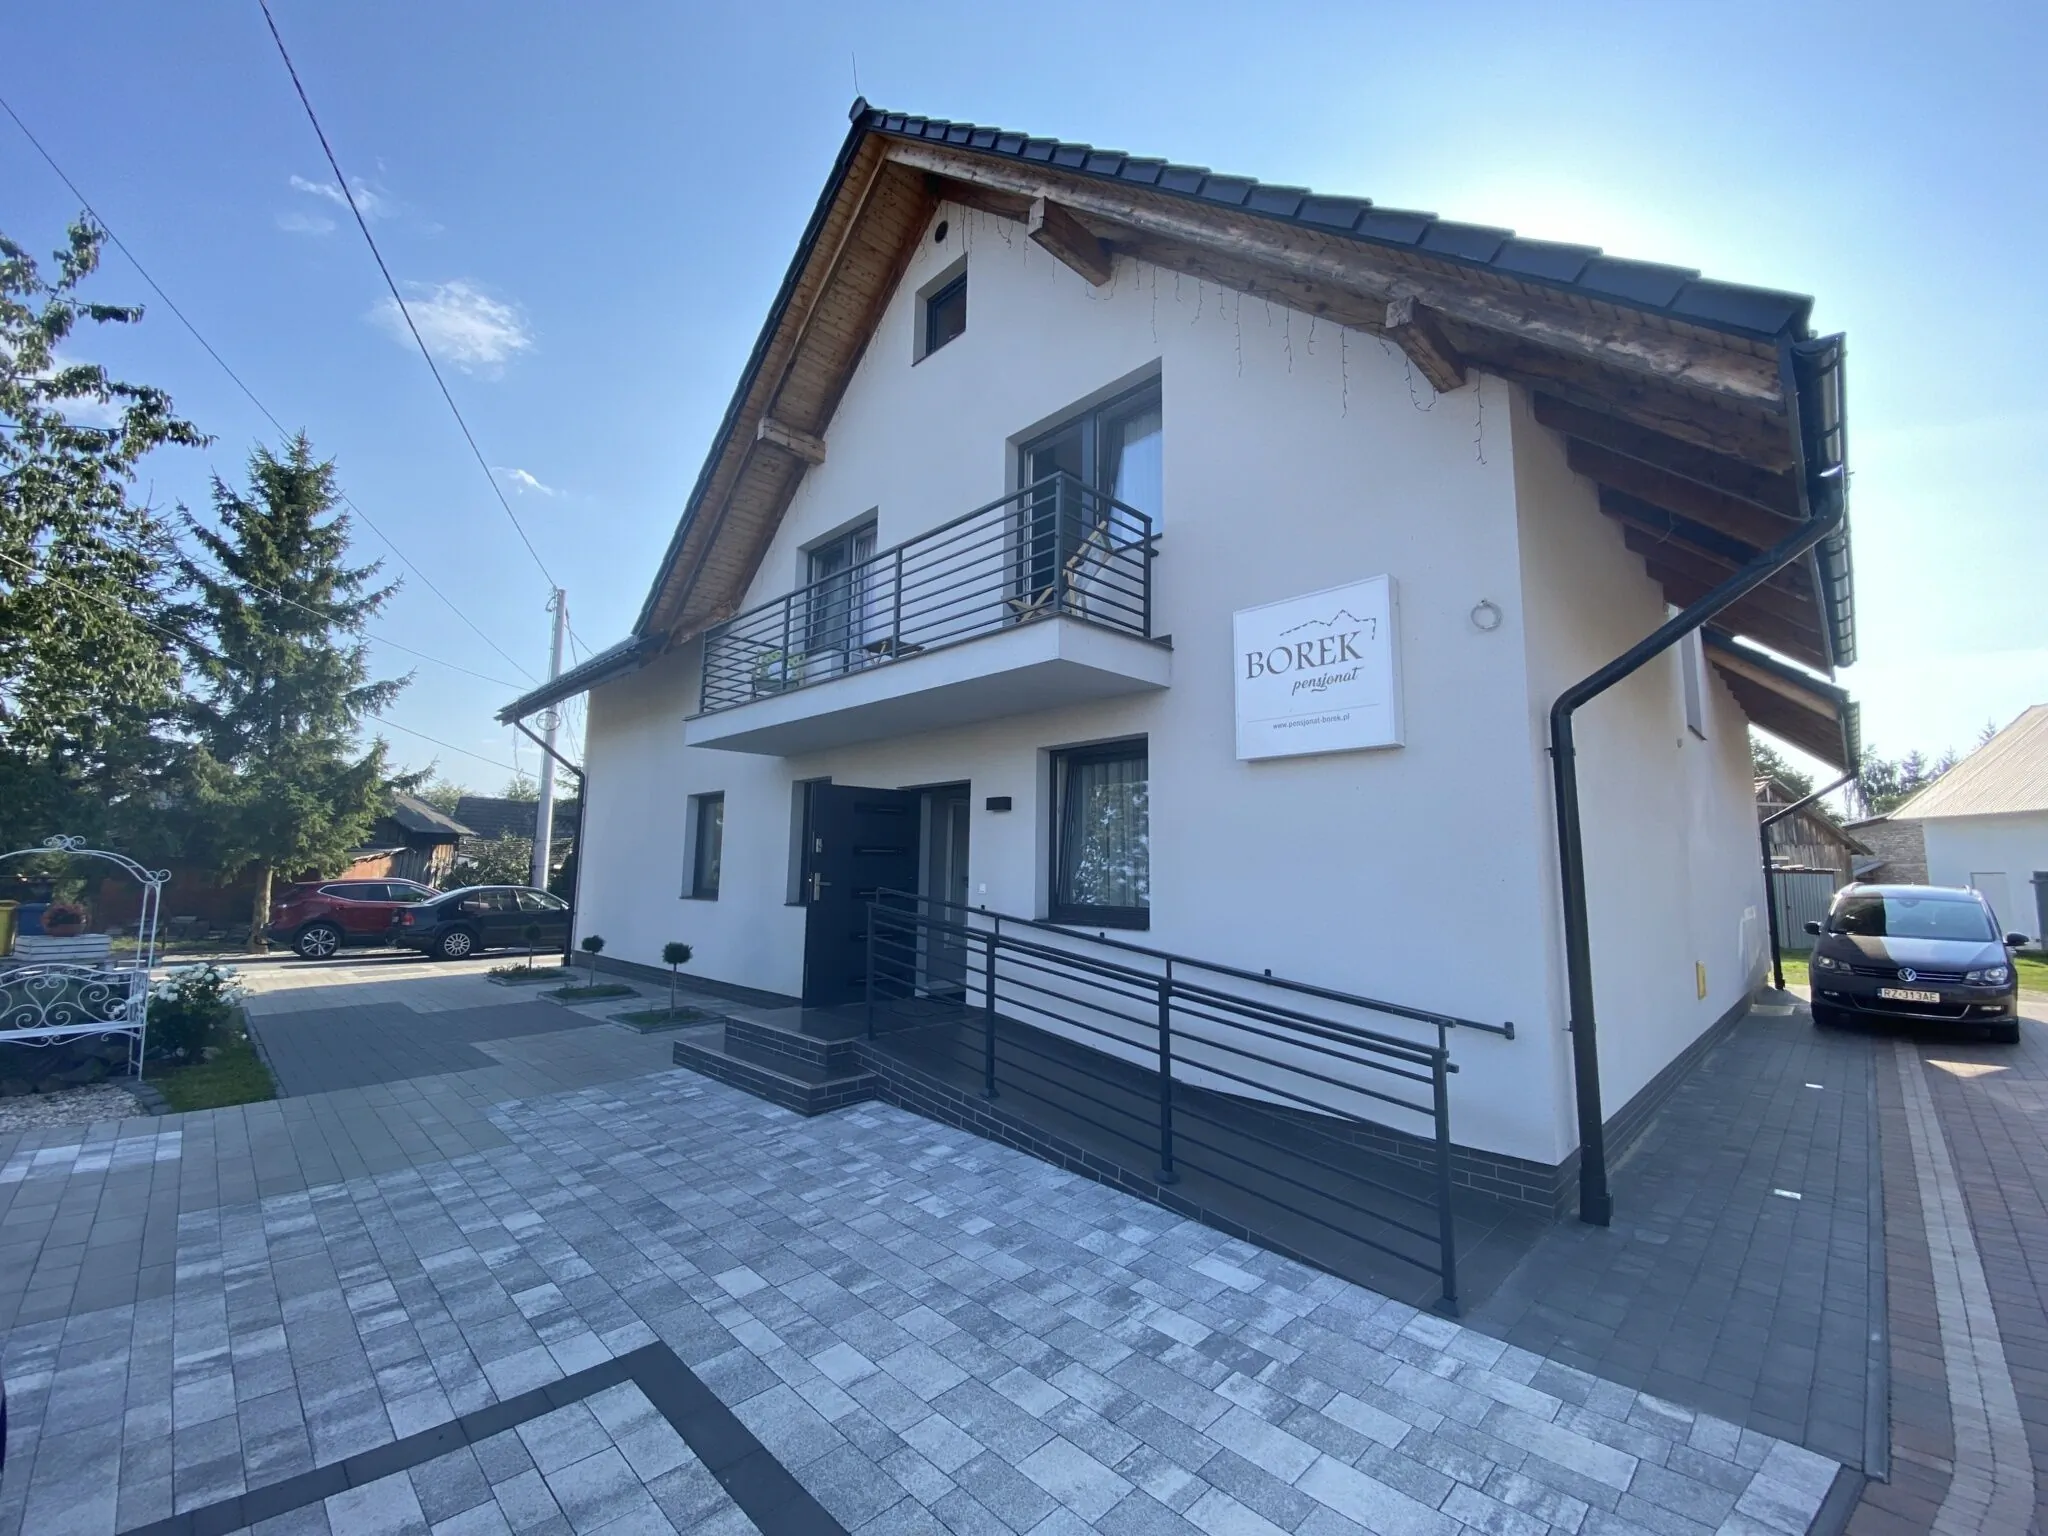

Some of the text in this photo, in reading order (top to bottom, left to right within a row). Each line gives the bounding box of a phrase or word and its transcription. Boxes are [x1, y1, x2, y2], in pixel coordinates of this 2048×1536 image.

[1245, 630, 1364, 680] BOREK
[1291, 666, 1365, 696] pensjonat
[1272, 713, 1350, 730] www.pensjonat-borek.pl
